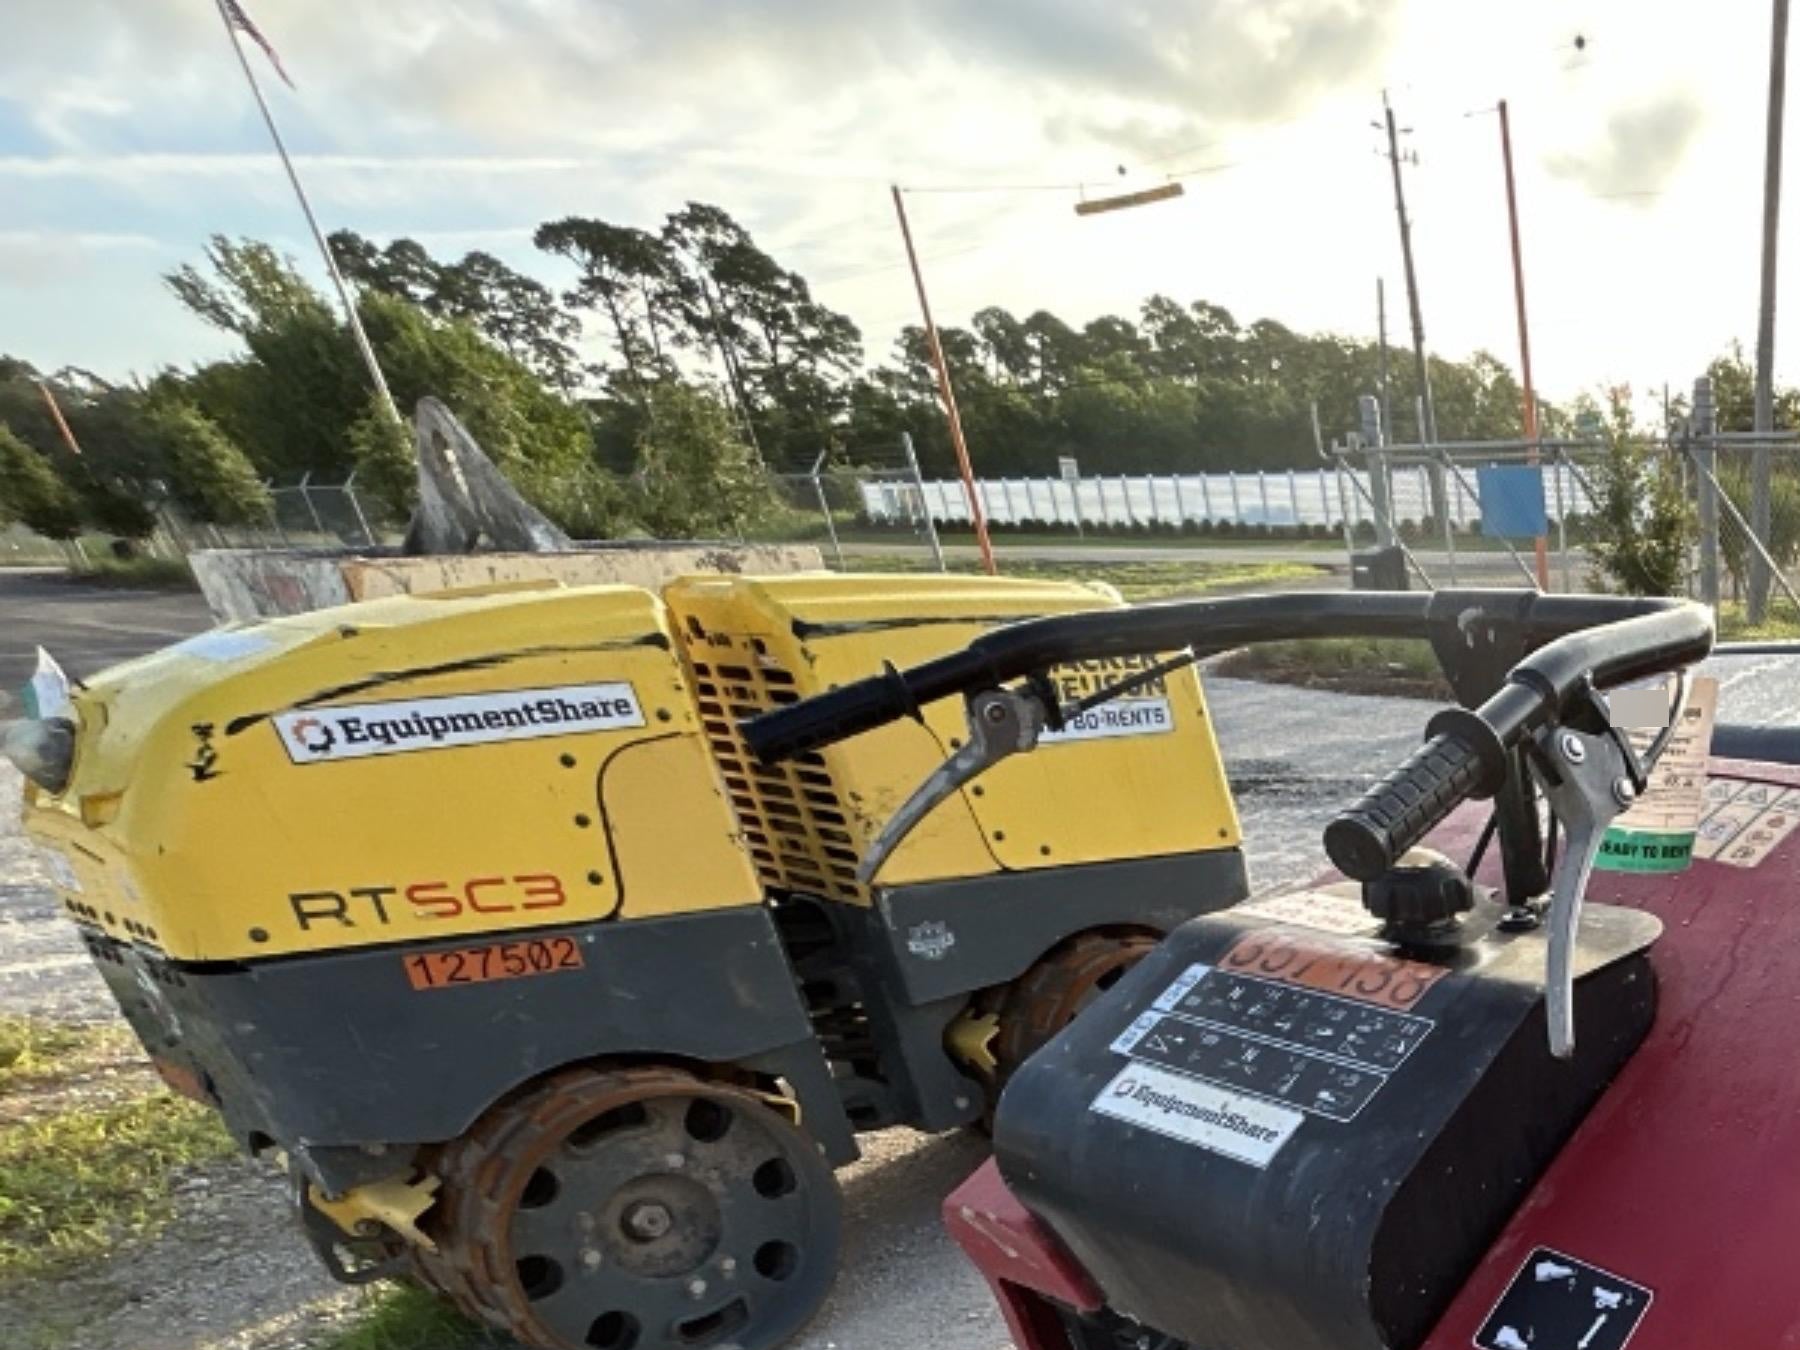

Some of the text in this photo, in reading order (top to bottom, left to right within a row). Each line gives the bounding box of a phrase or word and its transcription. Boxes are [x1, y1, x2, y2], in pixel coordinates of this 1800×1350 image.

[337, 694, 634, 745] EquipmentShare
[413, 938, 580, 985] 127502
[1131, 1085, 1279, 1143] EquipmentShare
